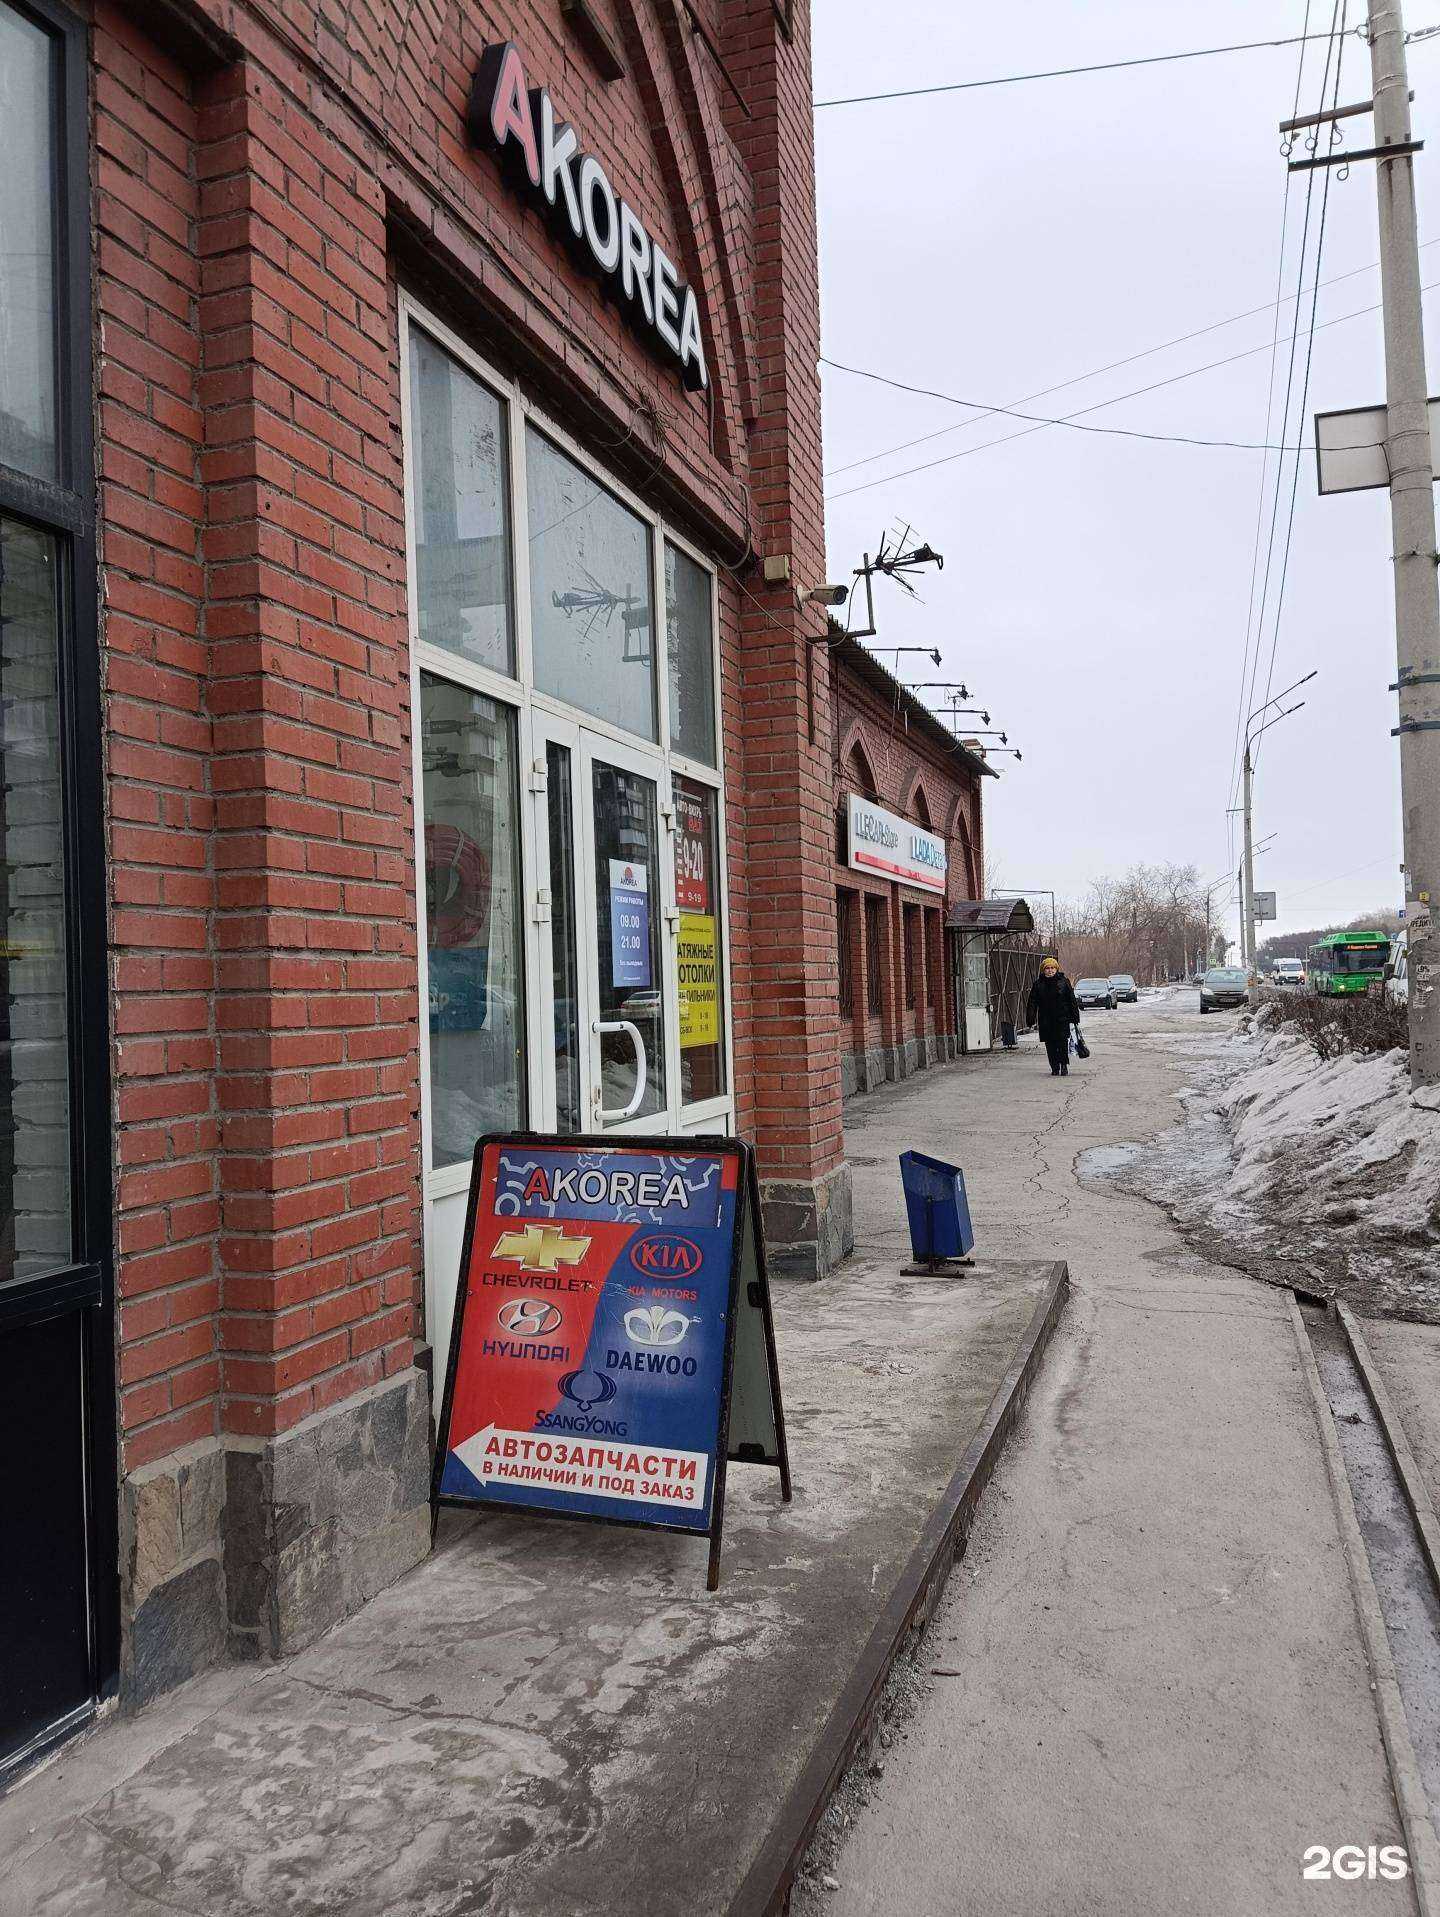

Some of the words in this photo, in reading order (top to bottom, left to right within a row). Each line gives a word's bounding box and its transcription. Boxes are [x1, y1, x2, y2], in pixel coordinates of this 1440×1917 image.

[491, 44, 709, 390] AKOREA
[684, 837, 703, 882] 9-20
[677, 943, 714, 960] АТЯЖНЫЕ
[678, 964, 715, 984] ОТОЛКИ
[523, 1166, 689, 1210] AKOREA
[640, 1242, 692, 1270] KIA
[482, 1272, 592, 1293] CHEVROLET
[628, 1285, 646, 1297] KIA
[651, 1287, 697, 1302] MOTORS
[482, 1339, 571, 1362] HYUNDAI
[605, 1349, 698, 1377] DAEWOO
[484, 1436, 697, 1481] АВТОЗАПЧАСТИ
[482, 1460, 493, 1474] В
[497, 1462, 577, 1486] НАЛИЧИИ
[582, 1474, 593, 1488] И
[598, 1475, 635, 1496] ПОД
[640, 1480, 695, 1502] ЗАКАЗ
